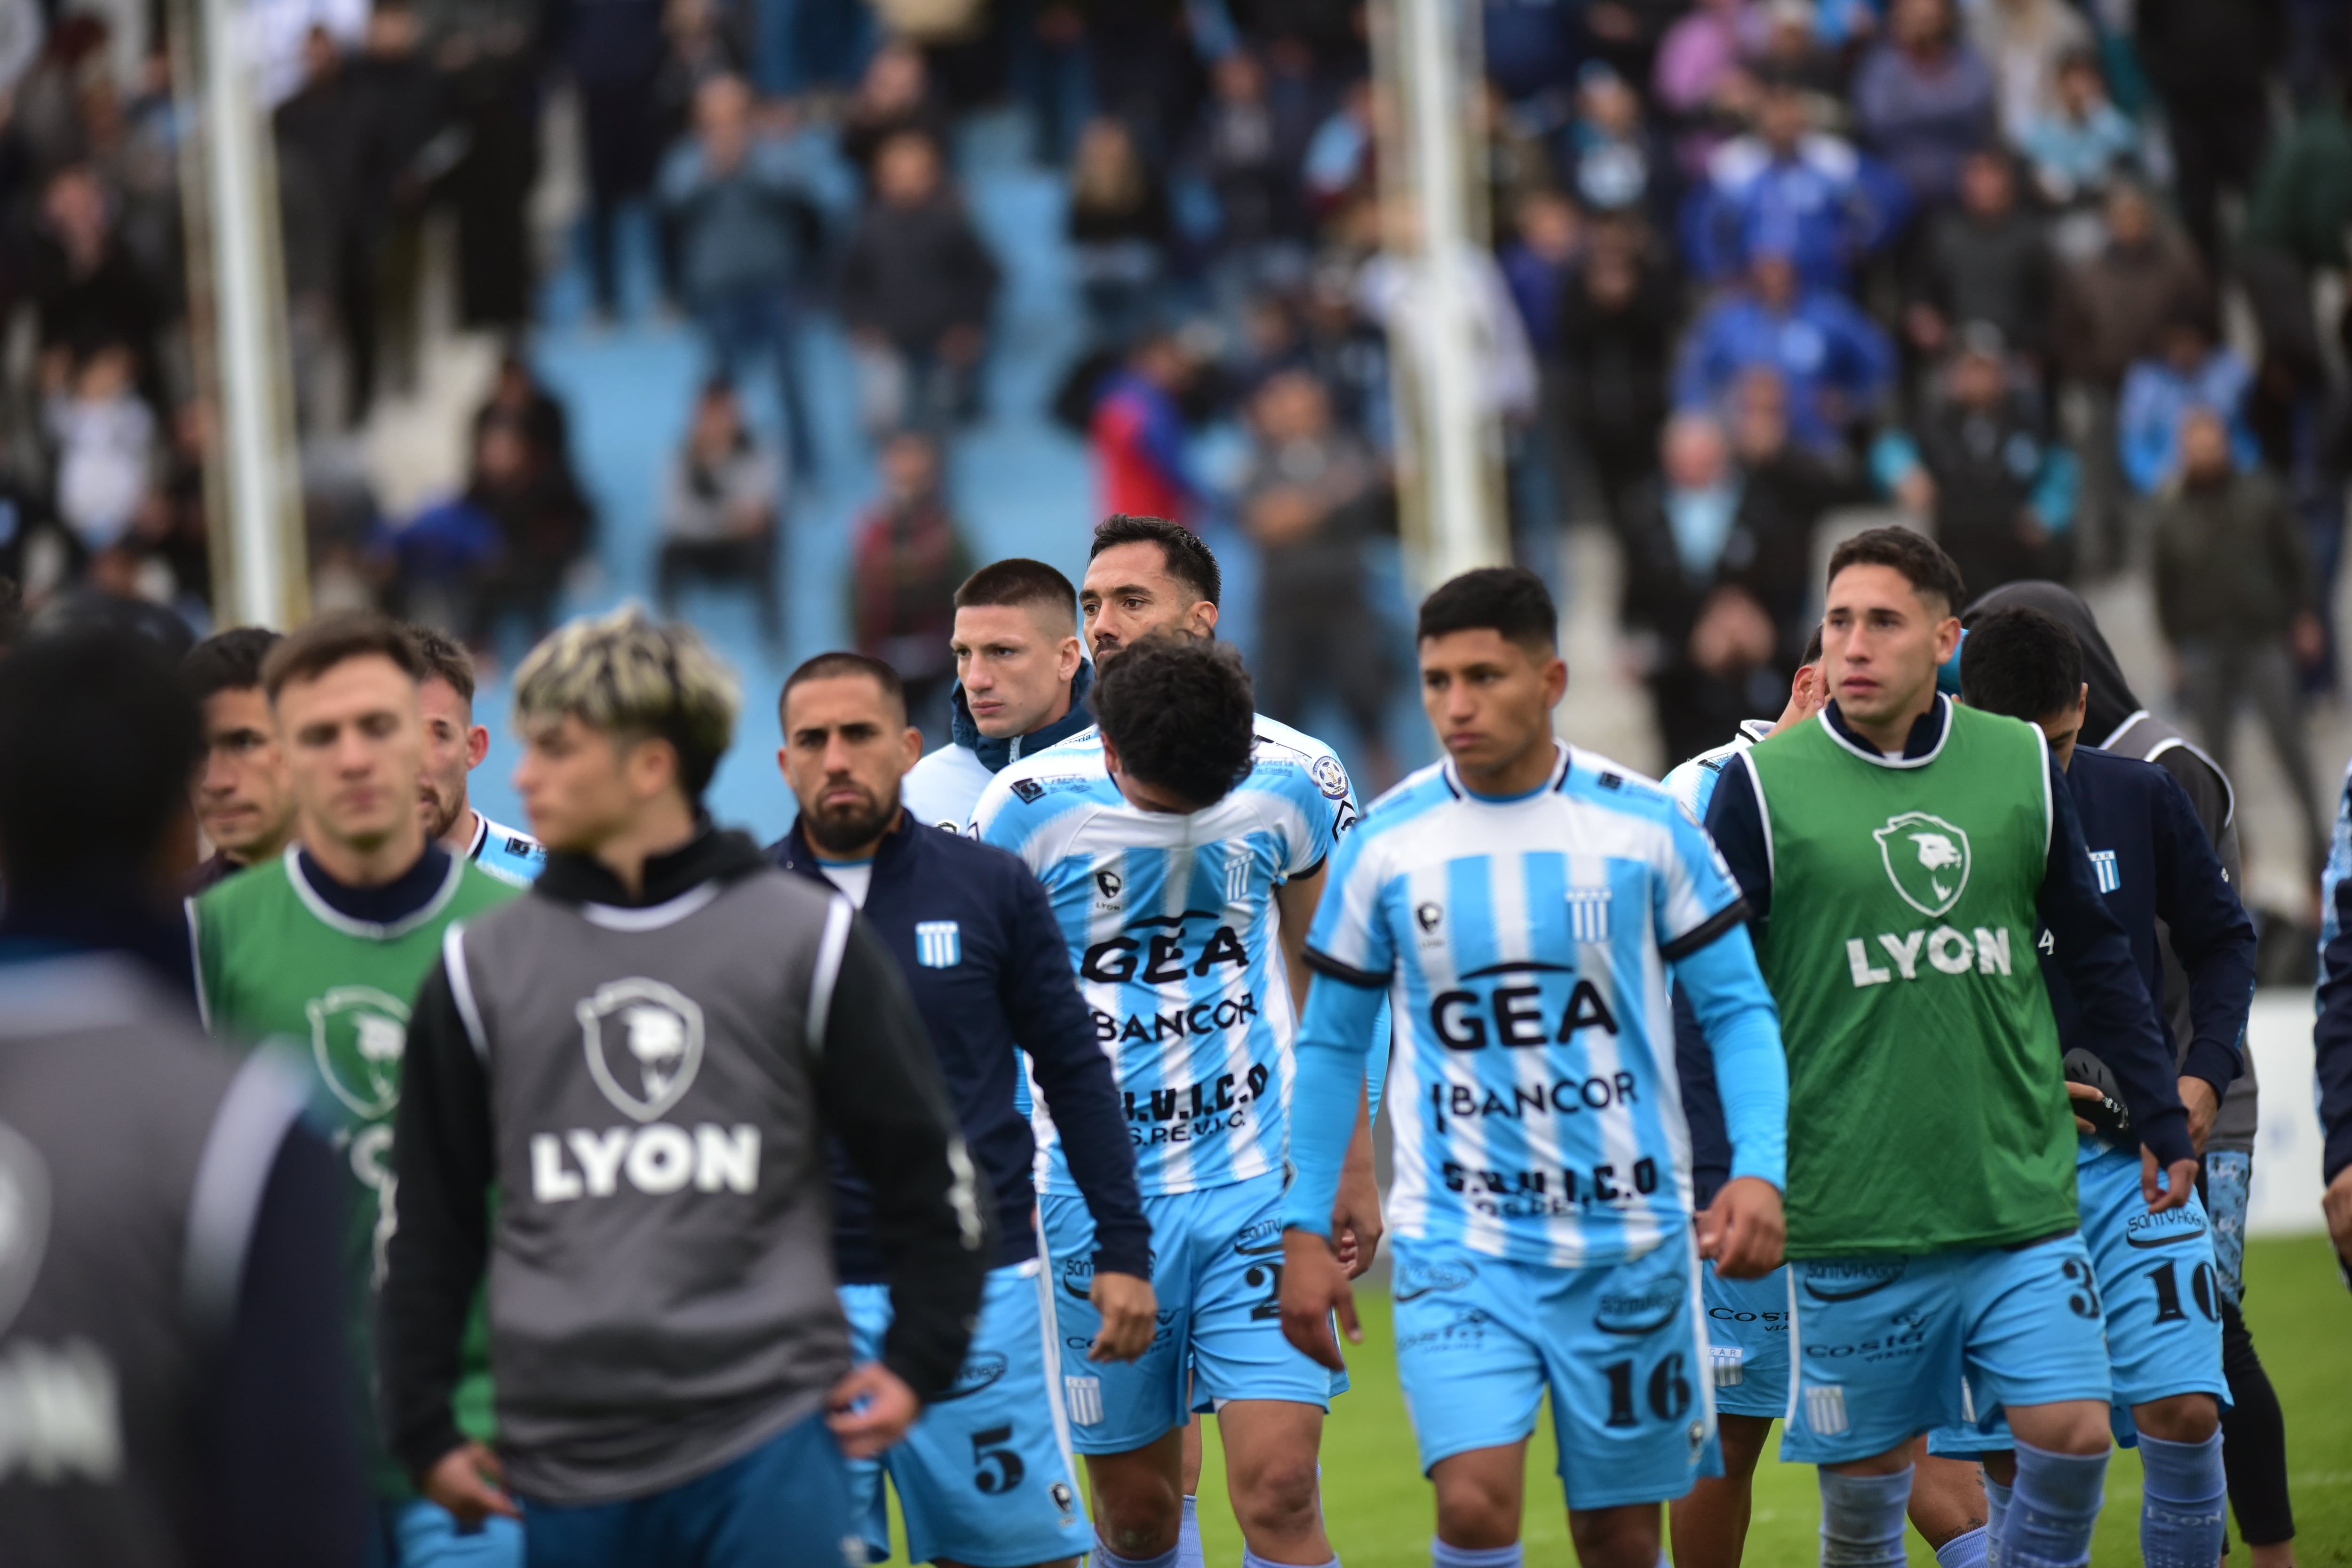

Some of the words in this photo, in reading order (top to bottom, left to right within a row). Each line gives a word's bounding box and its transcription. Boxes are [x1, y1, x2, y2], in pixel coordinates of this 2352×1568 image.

[1081, 925, 1249, 984] GEA
[1846, 925, 2011, 987] LYON
[2038, 928, 2054, 955] 4
[1091, 993, 1257, 1043] BANCOR
[1430, 979, 1618, 1051] GEA
[1451, 1072, 1638, 1120] BANCOR
[530, 1122, 762, 1204] LYON
[2063, 1258, 2100, 1319] 3
[2144, 1258, 2223, 1324] 10
[1603, 1350, 1691, 1428] 16
[971, 1425, 1025, 1496] 5
